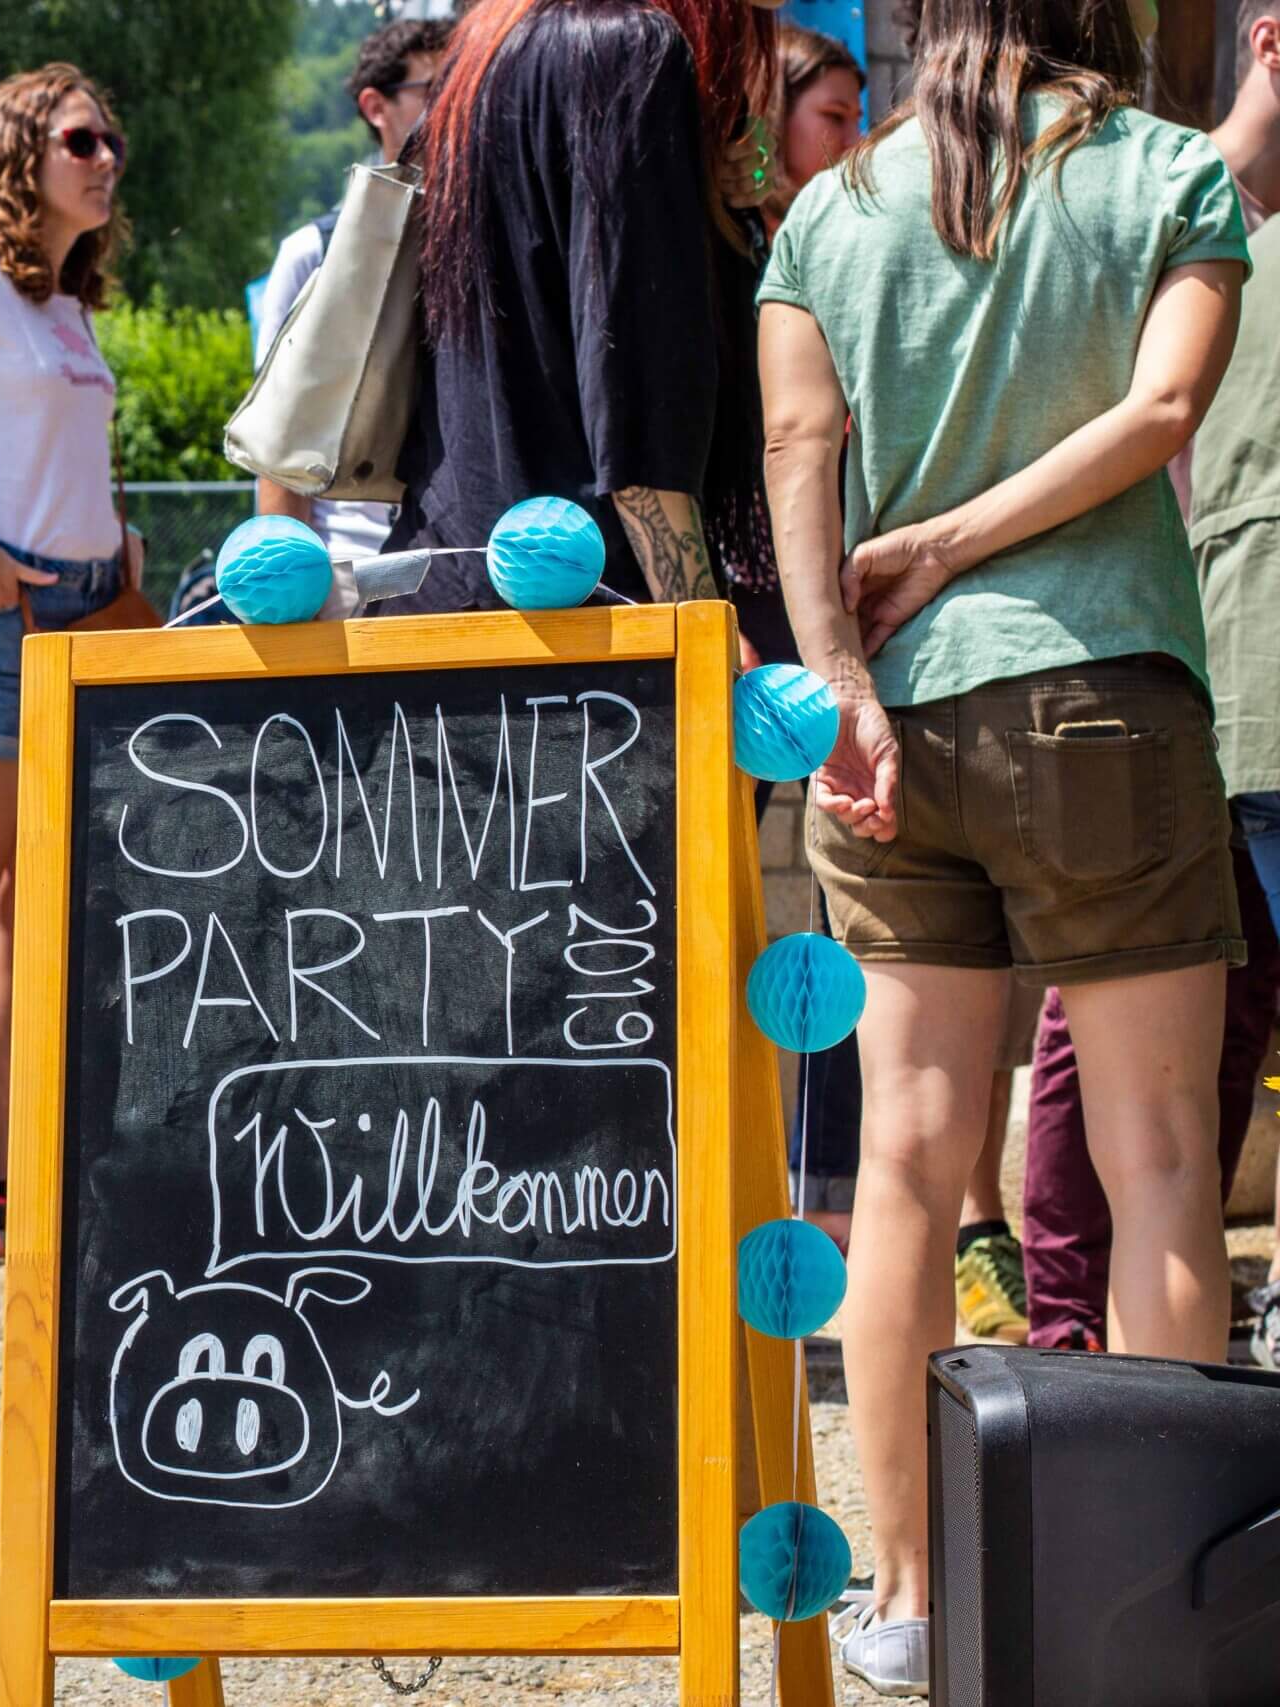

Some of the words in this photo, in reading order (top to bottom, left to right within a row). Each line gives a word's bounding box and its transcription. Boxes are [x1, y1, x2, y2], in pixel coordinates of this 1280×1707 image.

[118, 690, 657, 897] SOMMER
[116, 905, 549, 1056] PARTY
[563, 898, 658, 1051] 2019
[233, 1096, 669, 1242] Willkommen
